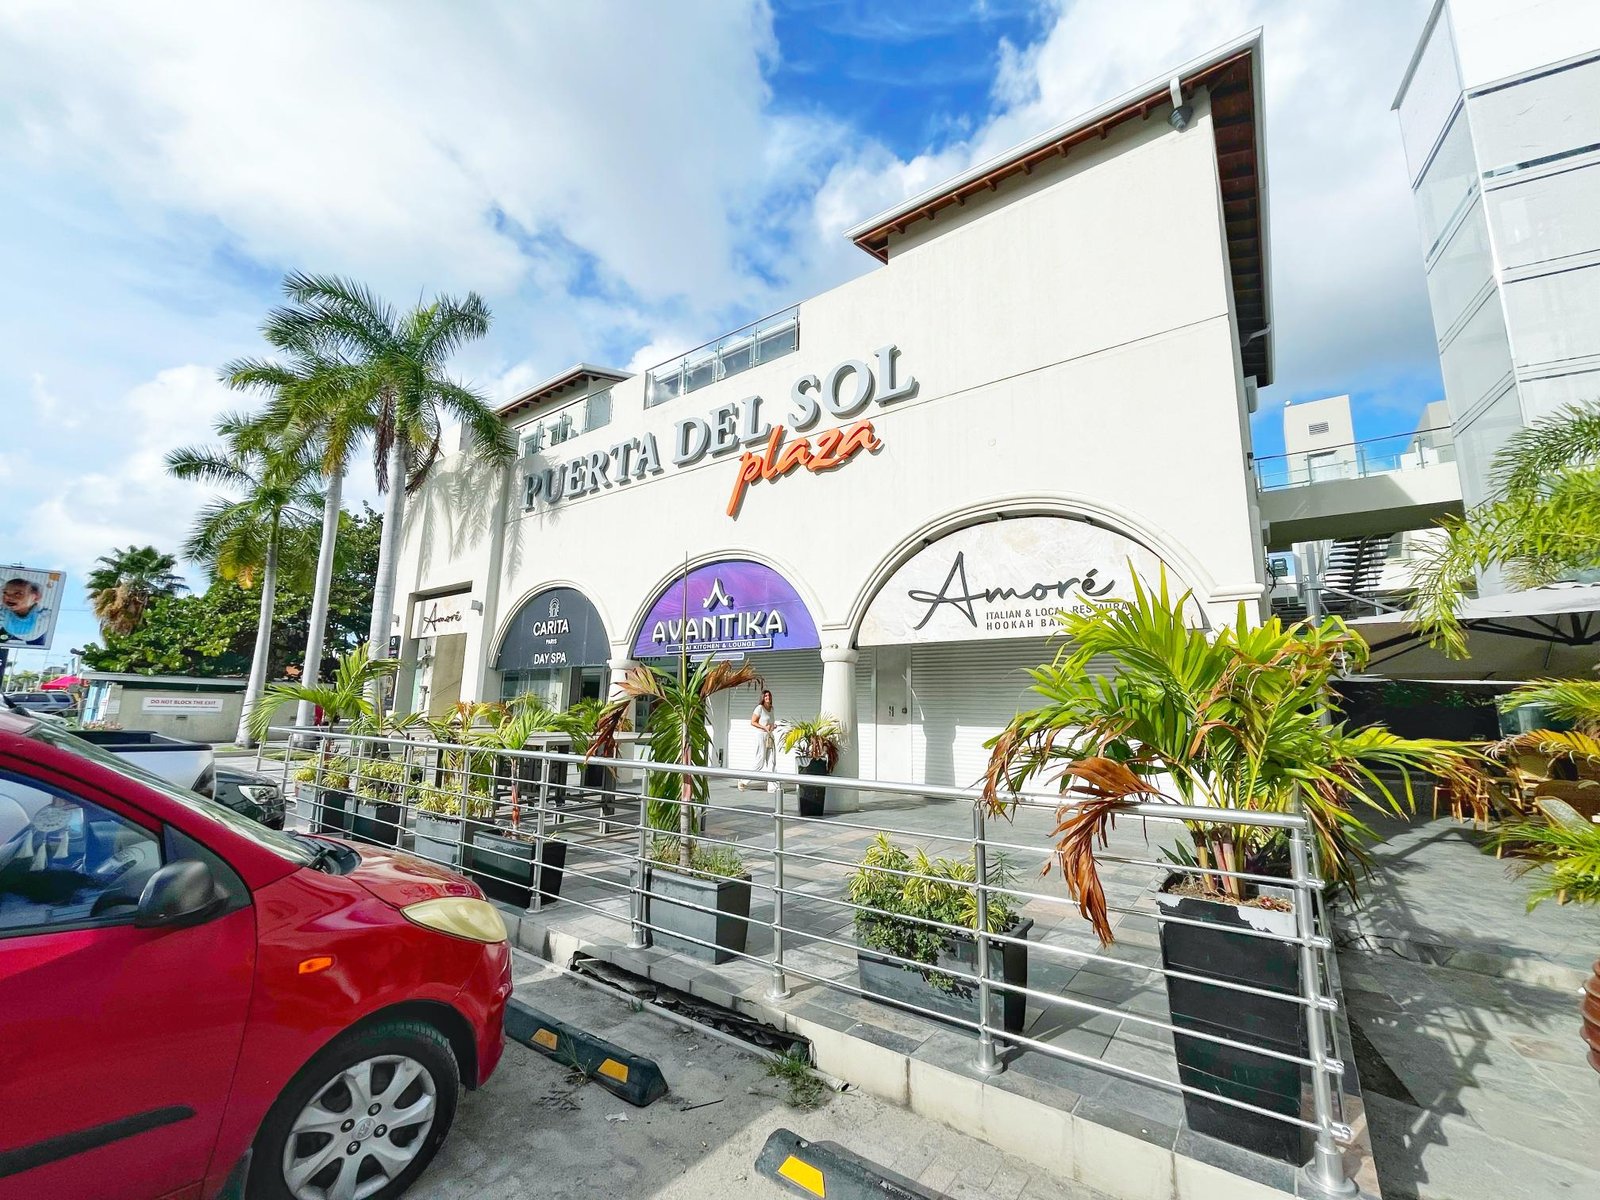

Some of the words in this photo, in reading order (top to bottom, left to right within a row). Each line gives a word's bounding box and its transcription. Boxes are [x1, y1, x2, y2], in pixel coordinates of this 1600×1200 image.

[521, 432, 662, 513] PUERTA
[672, 395, 771, 466] DEL
[787, 343, 915, 431] SOL
[726, 419, 881, 518] plaza
[908, 551, 1116, 630] Amoré
[651, 609, 786, 643] AVANTIKA
[986, 610, 1021, 620] ITALIAN
[1025, 608, 1031, 617] &
[986, 619, 1034, 630] HOOKAH
[533, 619, 569, 636] CARITA
[534, 653, 550, 665] DAY
[550, 651, 567, 664] SPA
